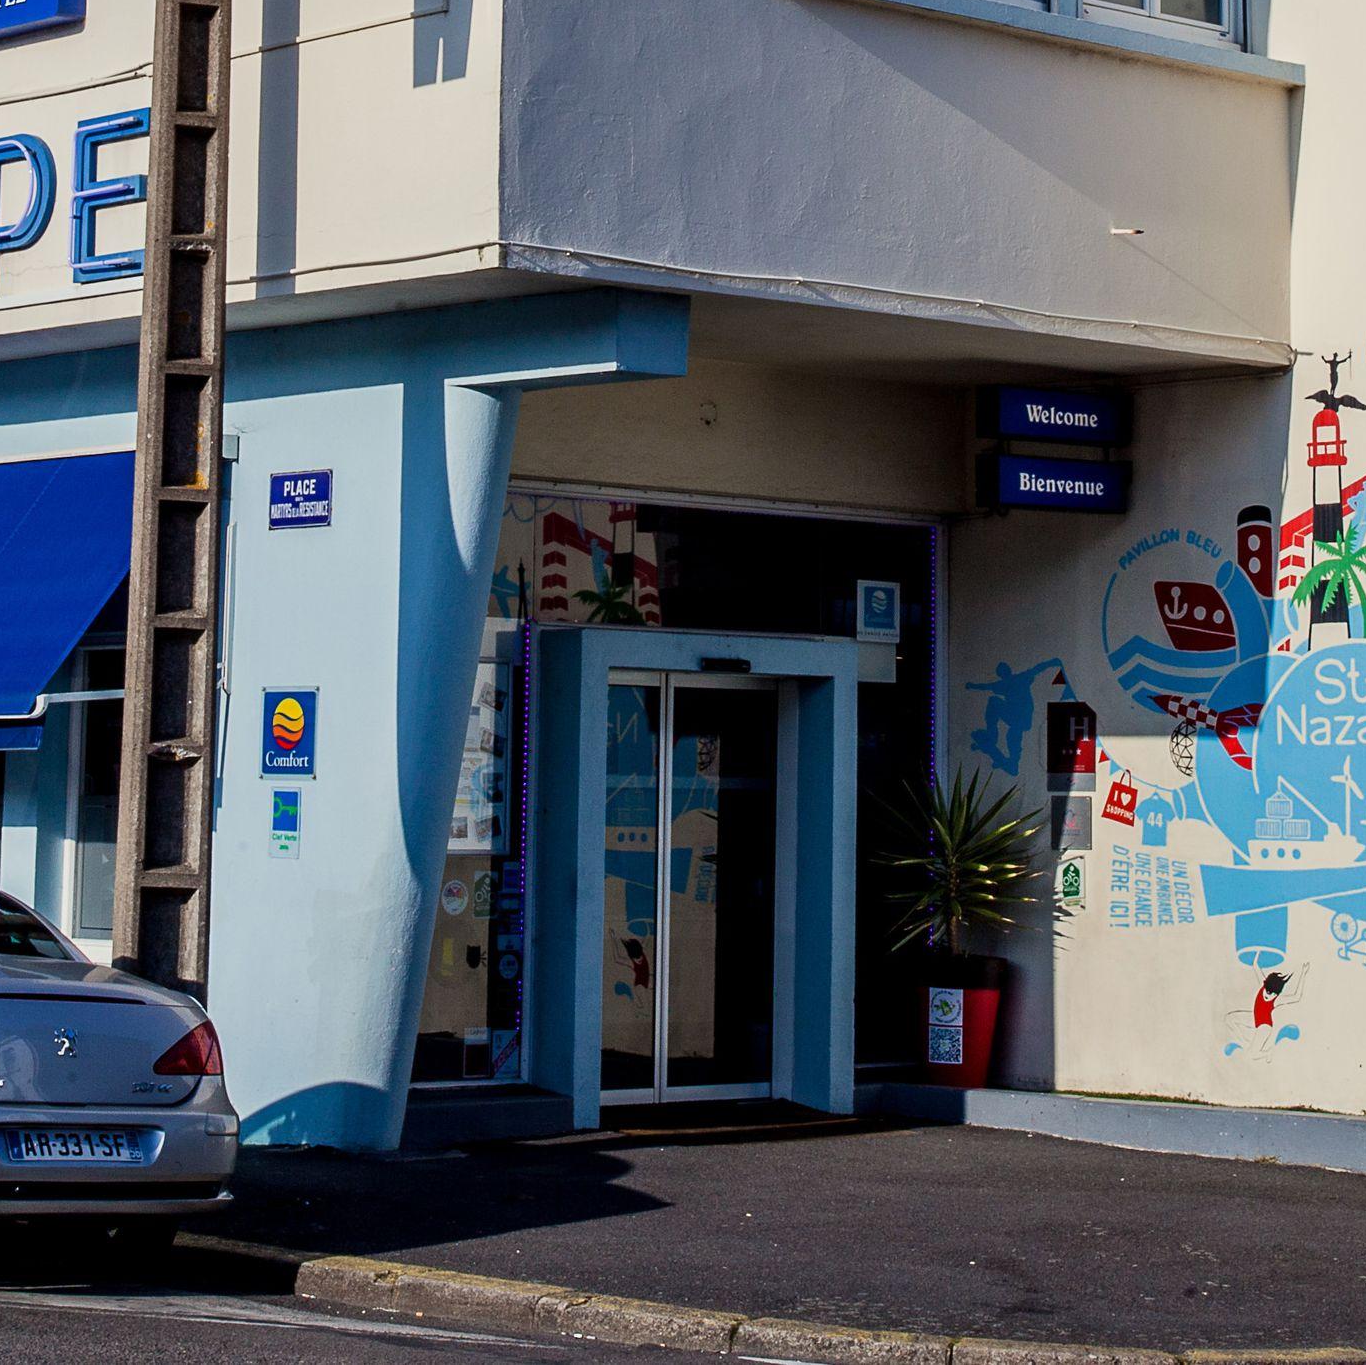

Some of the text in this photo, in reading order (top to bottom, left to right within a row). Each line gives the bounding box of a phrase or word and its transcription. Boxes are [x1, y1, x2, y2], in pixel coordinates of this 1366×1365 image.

[1026, 404, 1099, 428] Welcome
[283, 479, 316, 496] PLACE
[1019, 472, 1104, 496] Bienvenue
[1118, 528, 1223, 570] PAVILLON BLEU
[265, 750, 309, 767] Comfort
[1106, 804, 1134, 821] SHOPPING
[1147, 811, 1163, 827] 44
[1110, 844, 1134, 892] D'ÊTRE
[1134, 853, 1153, 927] UNE CHANCE
[1156, 856, 1175, 926] UNE AMBIANCE
[1172, 860, 1195, 924] UN DÉCOR
[23, 1130, 125, 1158] AR-331-SF
